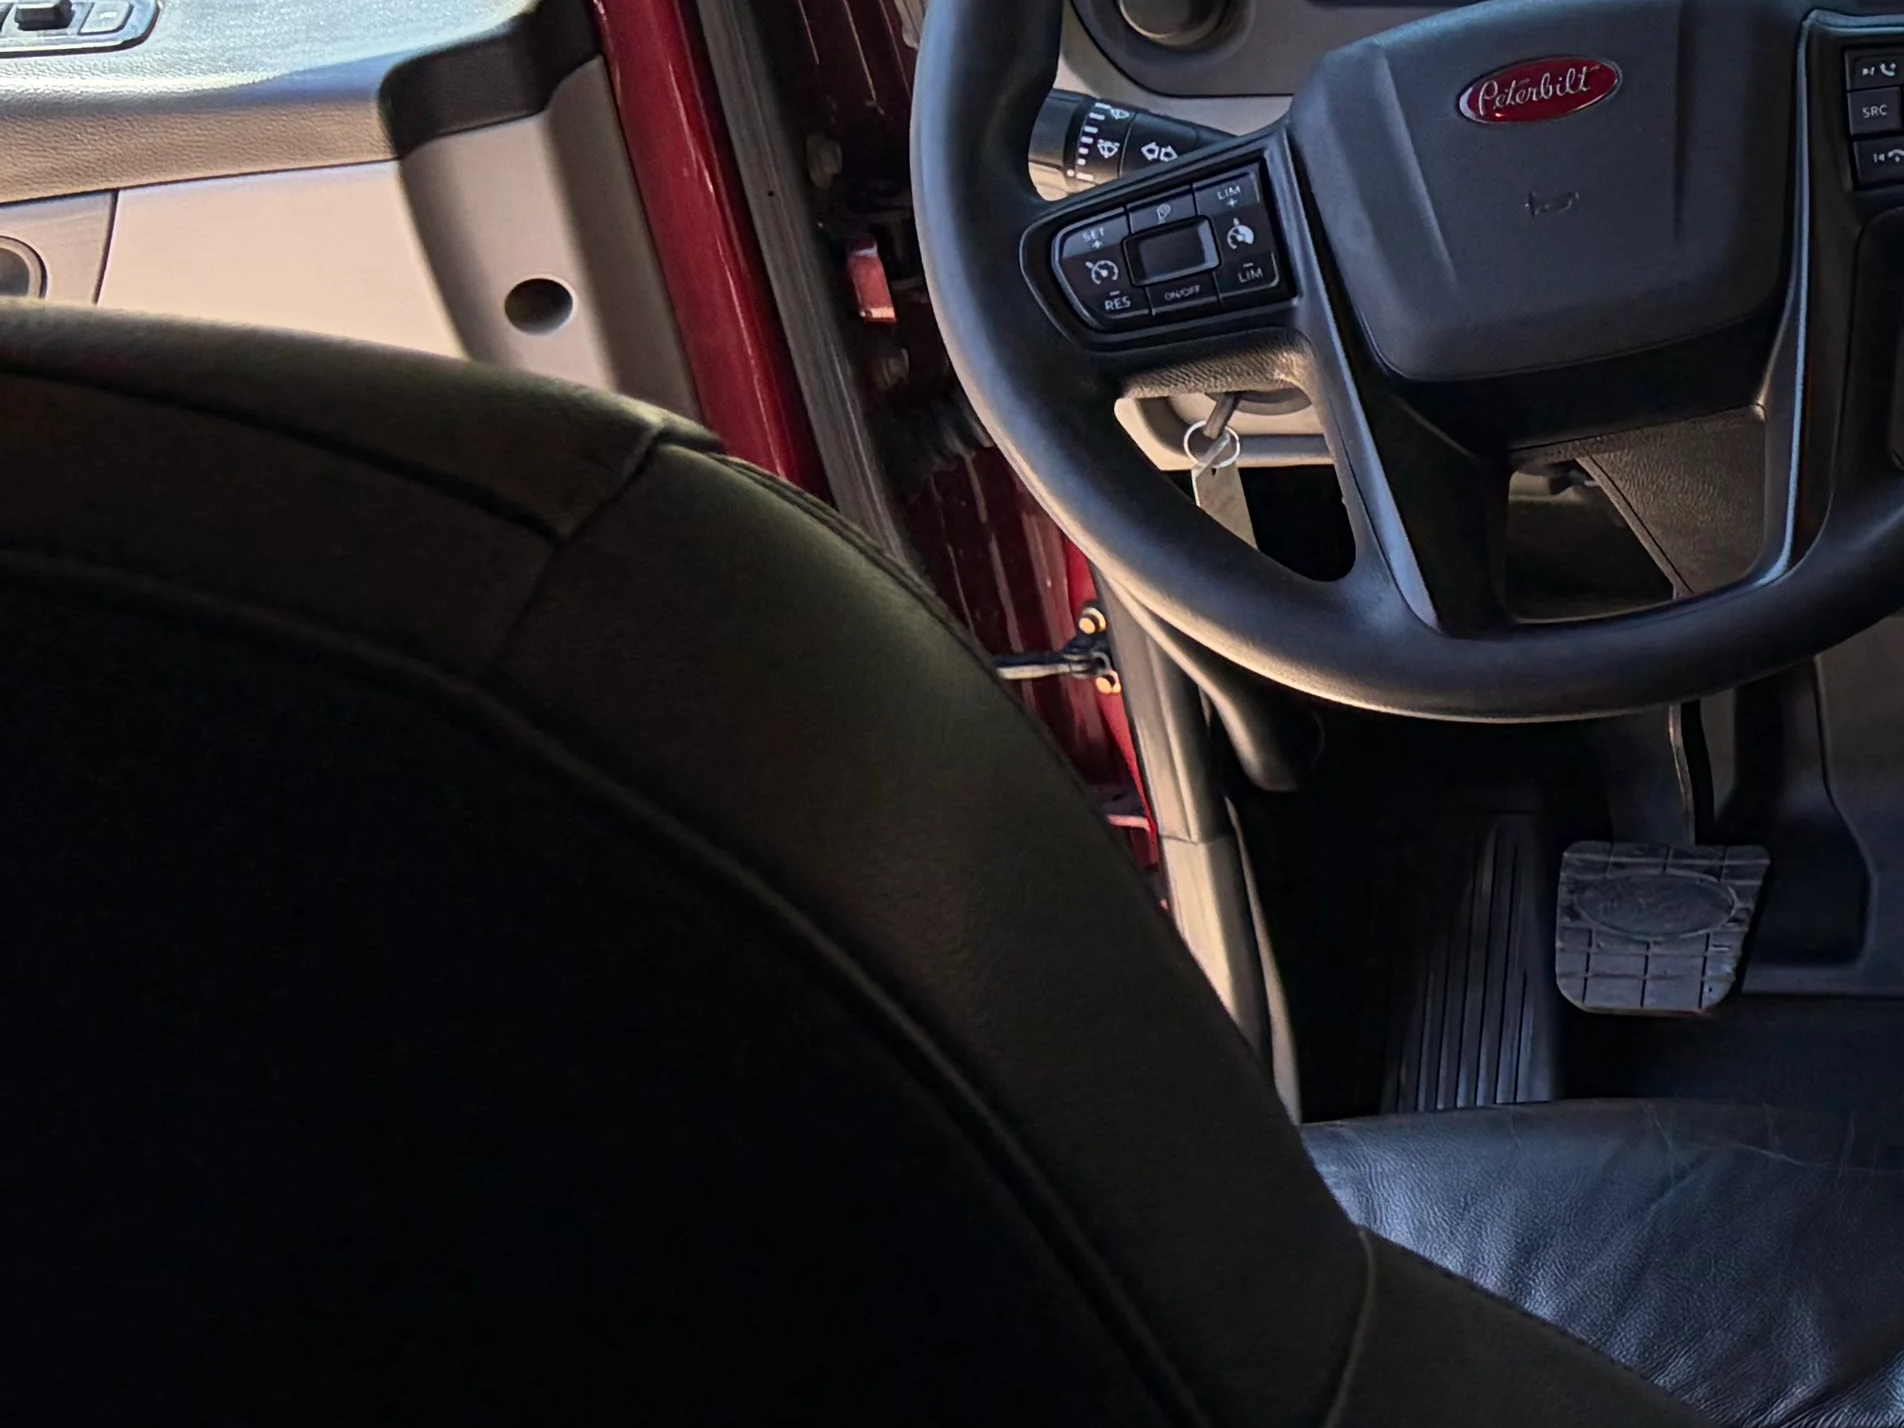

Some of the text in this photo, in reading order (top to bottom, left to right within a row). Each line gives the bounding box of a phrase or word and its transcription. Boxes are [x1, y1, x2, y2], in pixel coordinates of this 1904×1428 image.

[1479, 66, 1590, 116] Peterbilt
[1862, 104, 1888, 118] SRC
[1217, 185, 1241, 200] LIM
[1083, 228, 1104, 243] SET
[1238, 268, 1263, 283] LIM
[1104, 296, 1131, 312] RES
